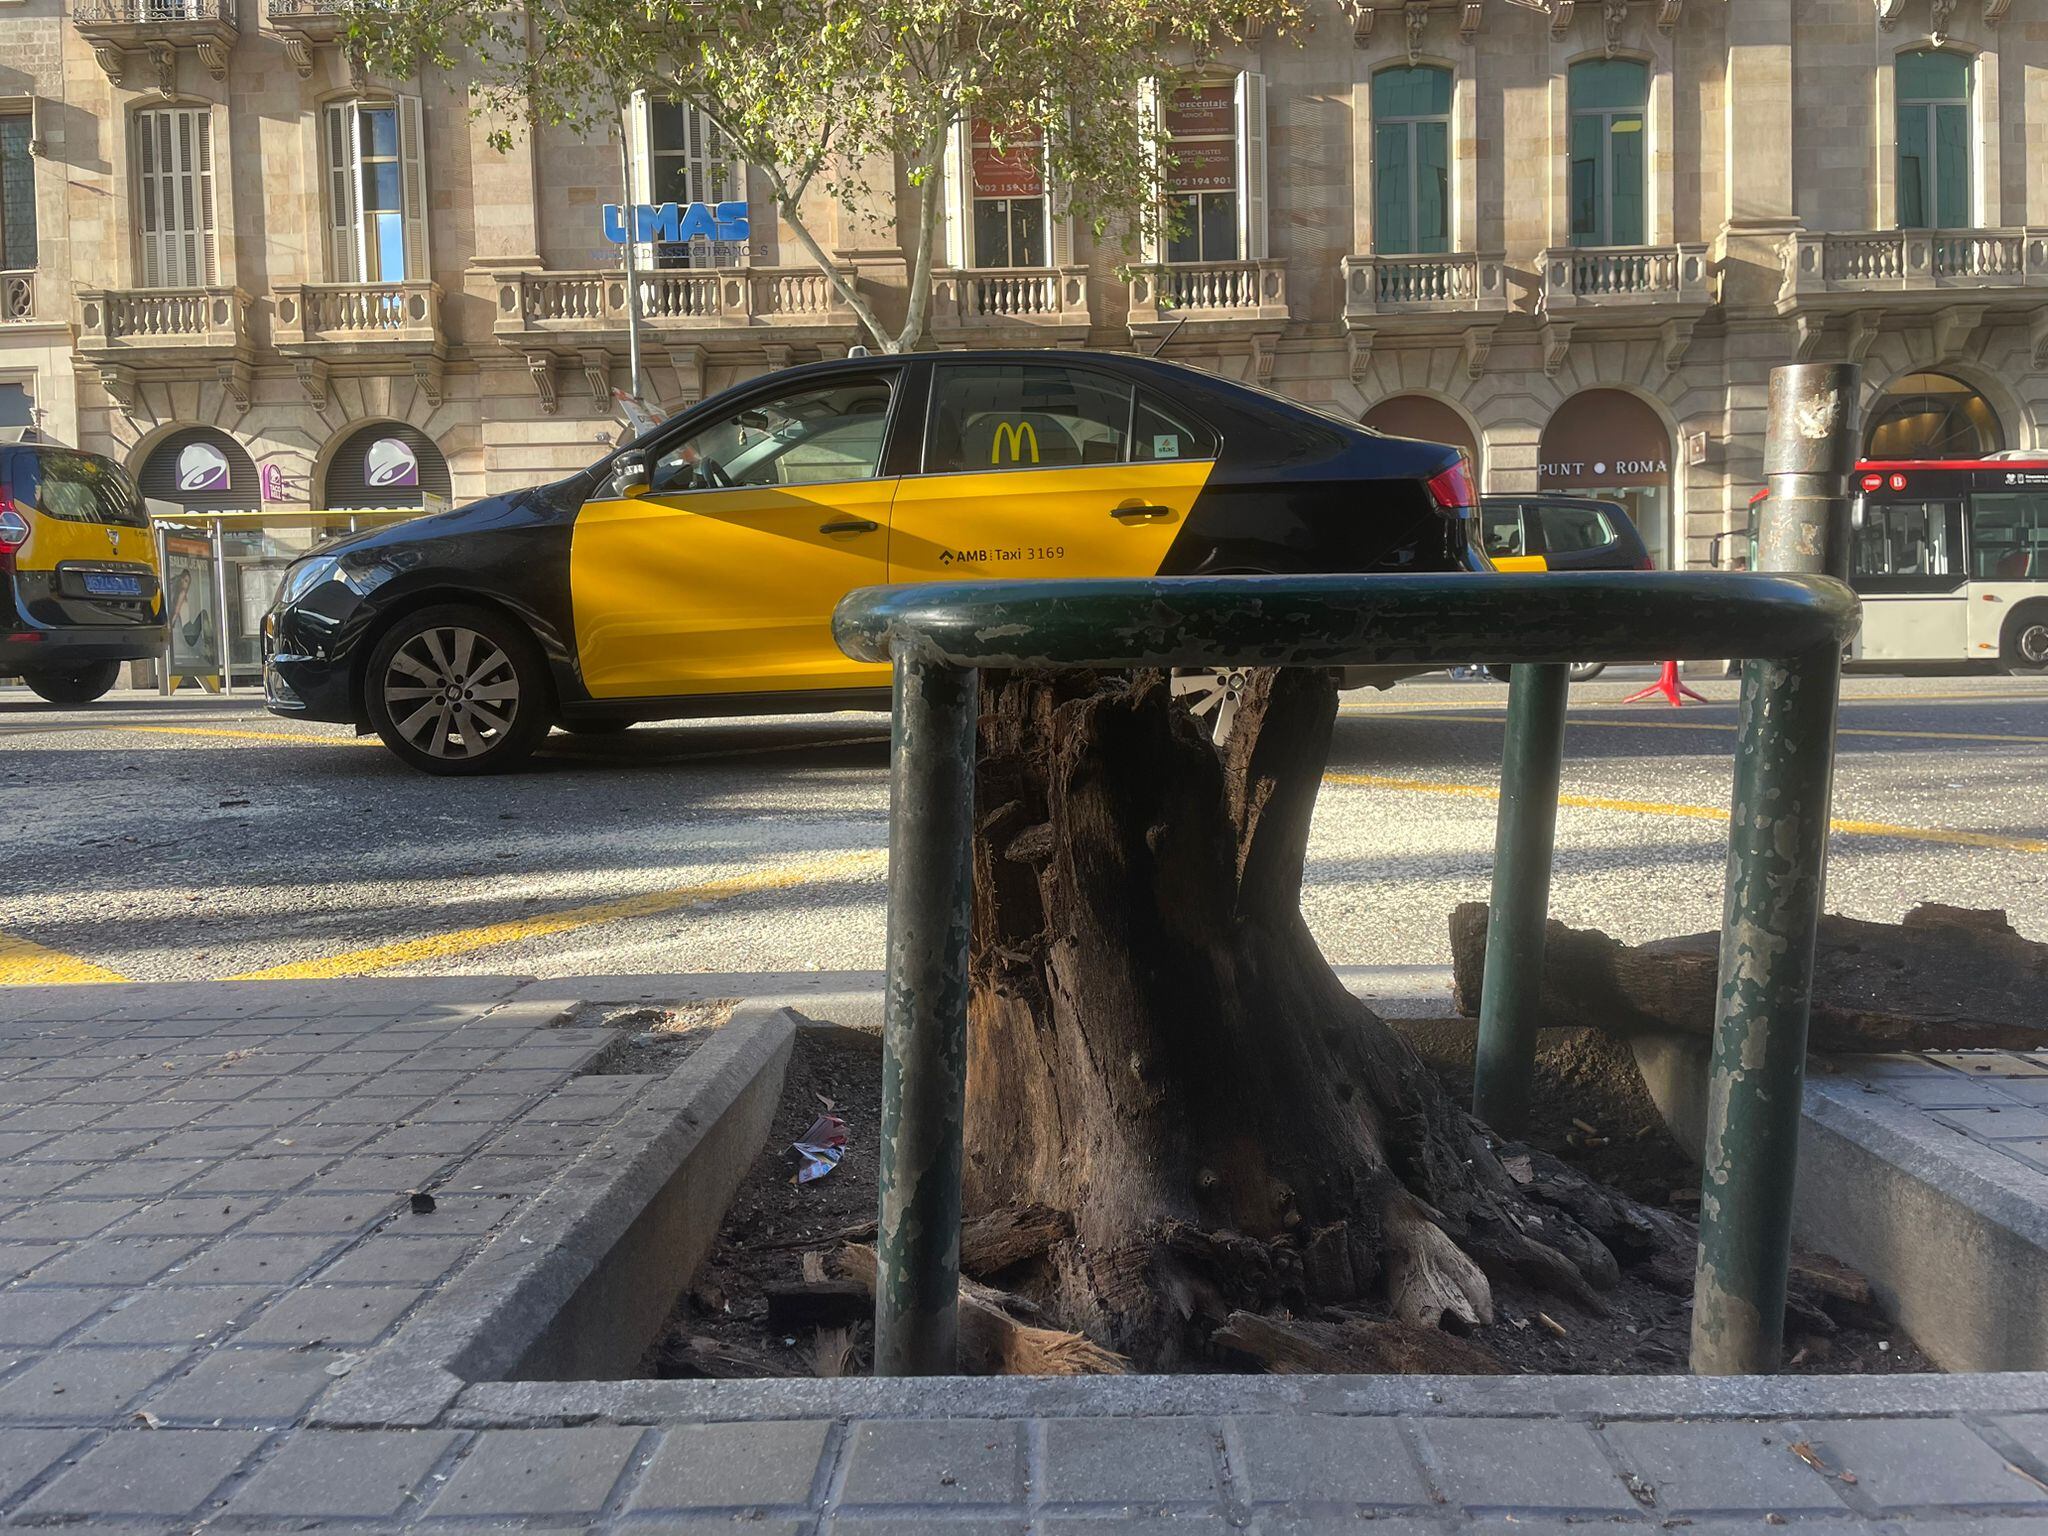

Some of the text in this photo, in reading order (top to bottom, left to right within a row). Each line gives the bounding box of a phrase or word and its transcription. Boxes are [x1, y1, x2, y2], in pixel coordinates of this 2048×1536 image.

[1192, 178, 1210, 186] 194
[1213, 177, 1231, 185] 901
[602, 201, 750, 244] UMAS
[1539, 461, 1668, 476] PUNT ROMA
[957, 547, 1065, 562] AMB Taxi 3169
